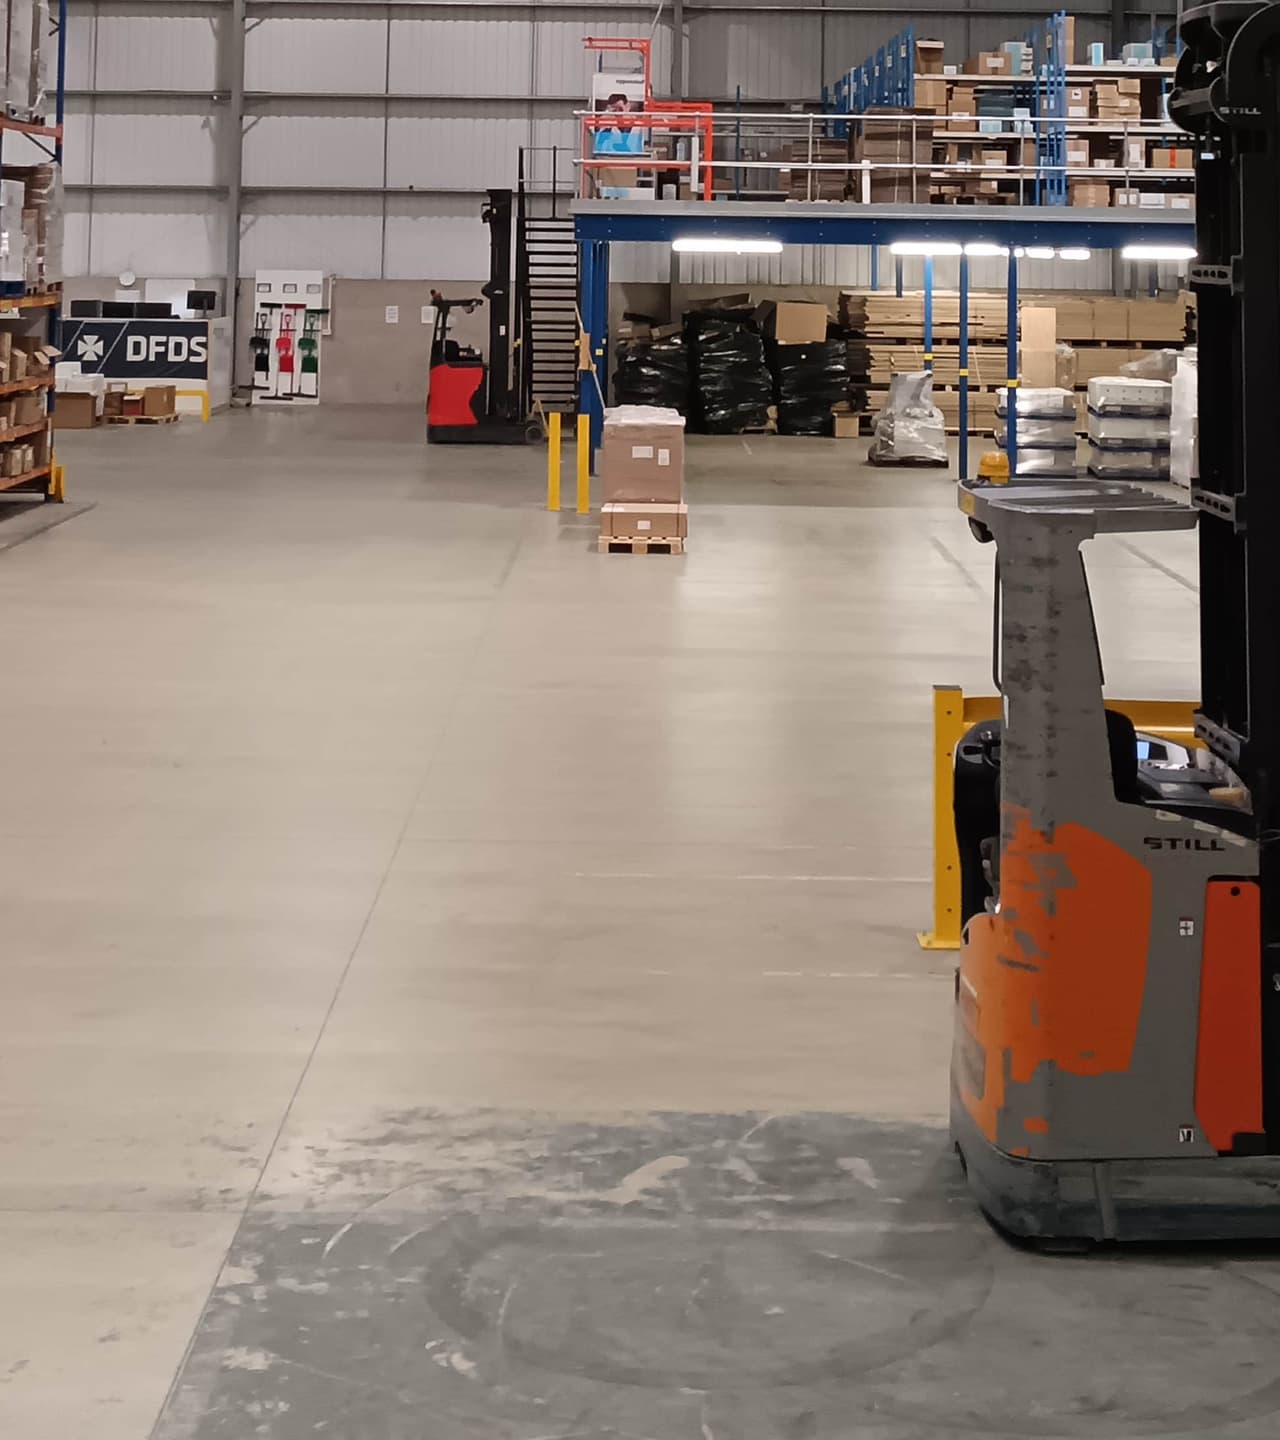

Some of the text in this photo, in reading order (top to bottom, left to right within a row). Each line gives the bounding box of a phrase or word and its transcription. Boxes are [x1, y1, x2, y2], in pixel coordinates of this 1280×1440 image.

[1219, 107, 1261, 115] STILL
[126, 335, 207, 362] DFDS
[1144, 837, 1226, 851] STILL
